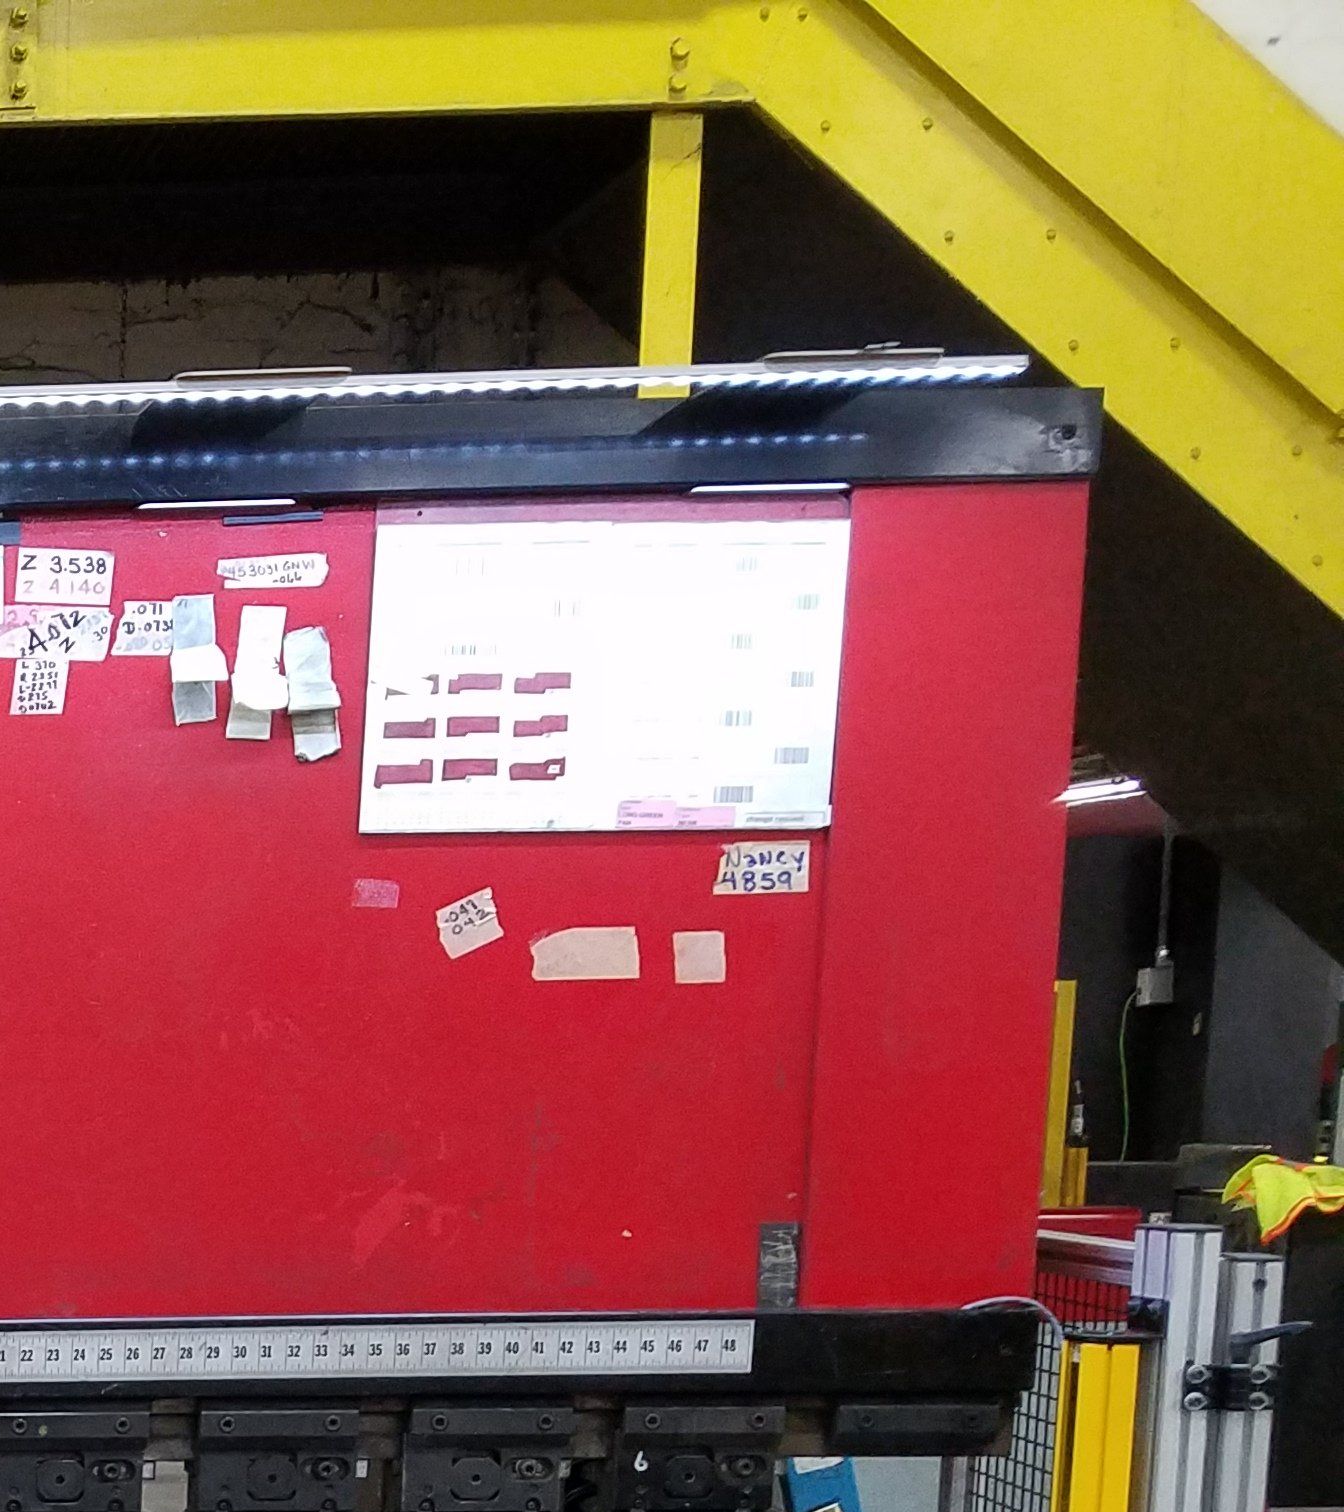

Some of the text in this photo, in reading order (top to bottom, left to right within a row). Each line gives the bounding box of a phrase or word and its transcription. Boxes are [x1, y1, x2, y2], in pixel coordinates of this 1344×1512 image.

[20, 554, 107, 574] Z 3.538
[720, 870, 793, 892] 4859
[20, 1349, 33, 1362] 22
[46, 1349, 60, 1361] 23
[73, 1348, 86, 1361] 24
[99, 1348, 112, 1361] 25
[126, 1348, 140, 1360] 26
[153, 1347, 166, 1360] 27
[179, 1347, 193, 1360] 28
[206, 1346, 219, 1359] 29
[233, 1345, 247, 1358] 30
[261, 1345, 272, 1358] 31
[287, 1345, 301, 1357] 32
[314, 1344, 328, 1357] 33
[341, 1344, 355, 1357] 34
[368, 1344, 383, 1356] 35
[396, 1343, 410, 1356] 36
[424, 1343, 437, 1356] 37
[451, 1343, 464, 1355] 38
[477, 1342, 492, 1355] 39
[505, 1342, 519, 1355] 40
[532, 1342, 544, 1354] 41
[560, 1341, 574, 1354] 42
[587, 1341, 601, 1354] 43
[613, 1341, 627, 1353] 44
[640, 1340, 655, 1353] 45
[667, 1340, 682, 1353] 46
[695, 1339, 709, 1352] 47
[722, 1339, 736, 1352] 48
[634, 1450, 648, 1471] 6
